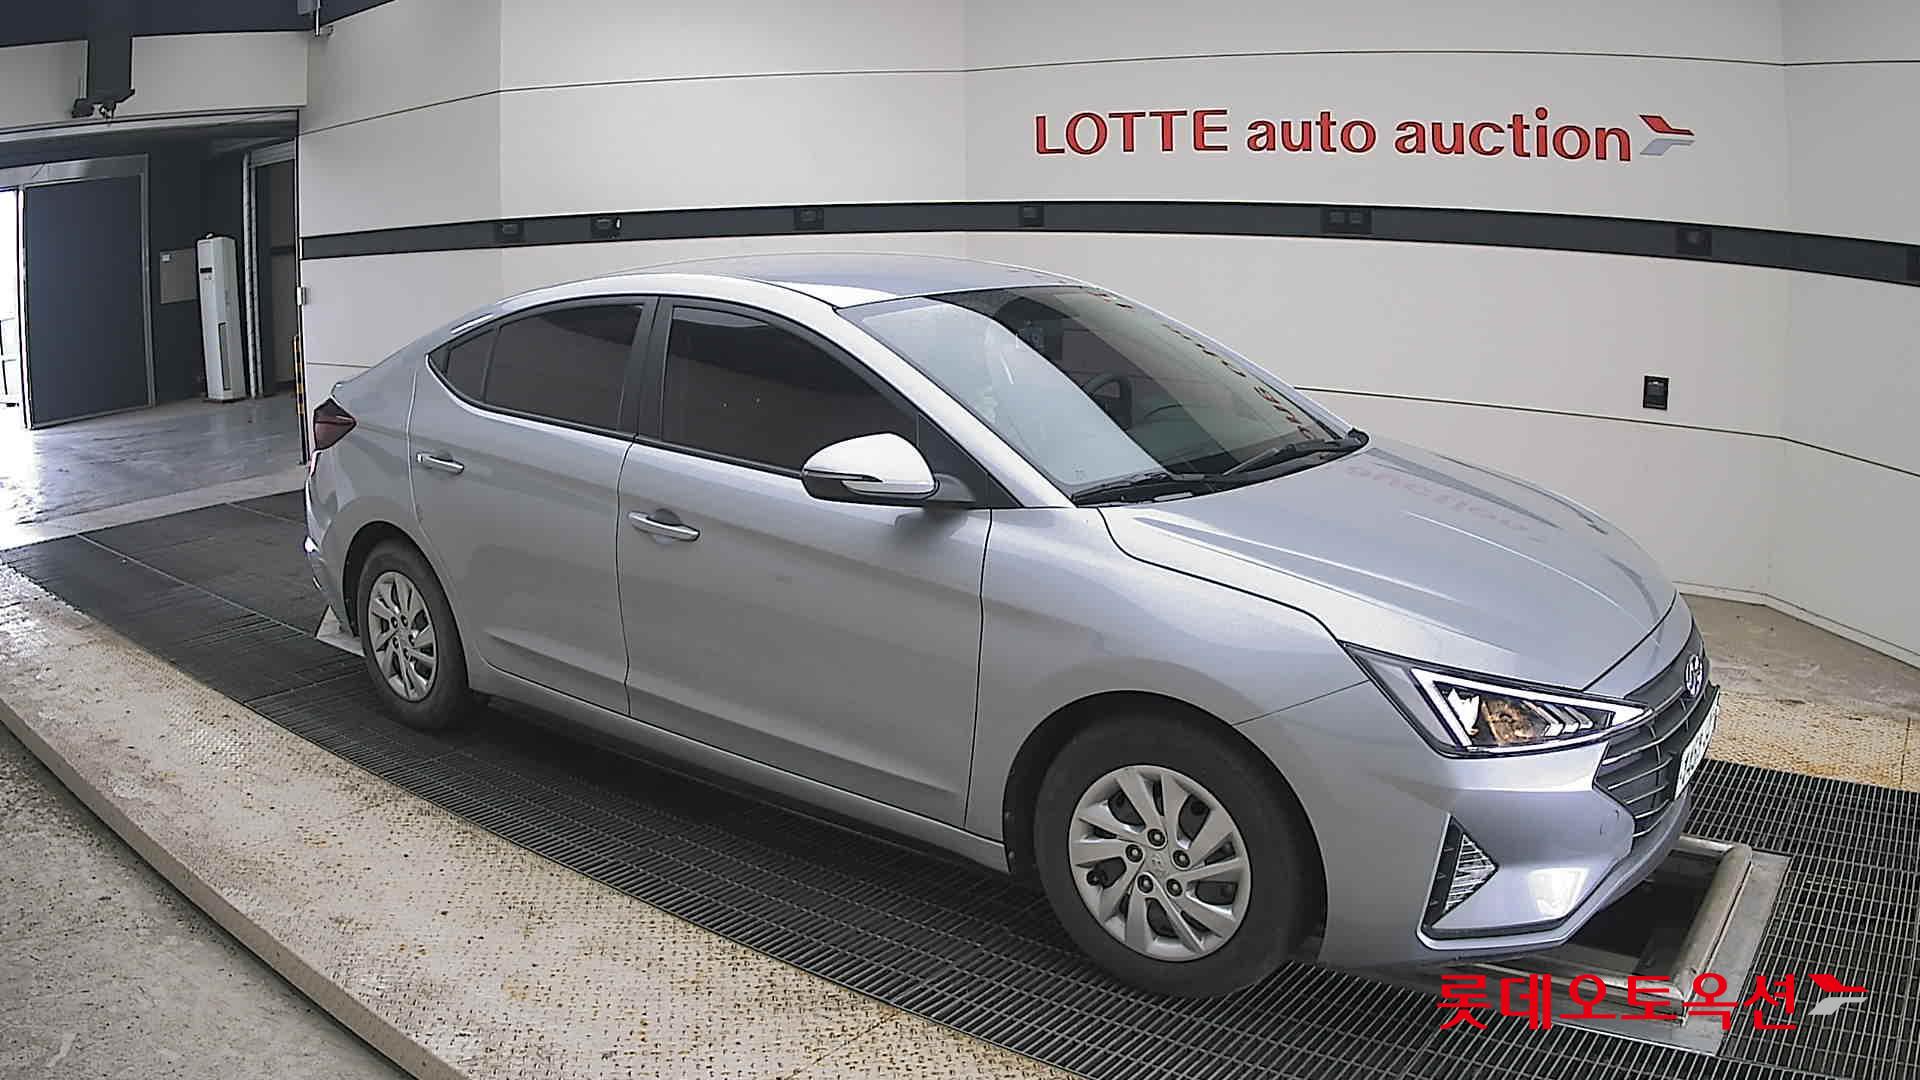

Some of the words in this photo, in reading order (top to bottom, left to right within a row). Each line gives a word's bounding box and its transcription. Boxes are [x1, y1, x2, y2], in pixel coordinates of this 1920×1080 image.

[1034, 109, 1229, 156] LOTTE
[1246, 110, 1377, 154] auto
[1394, 106, 1632, 162] auction
